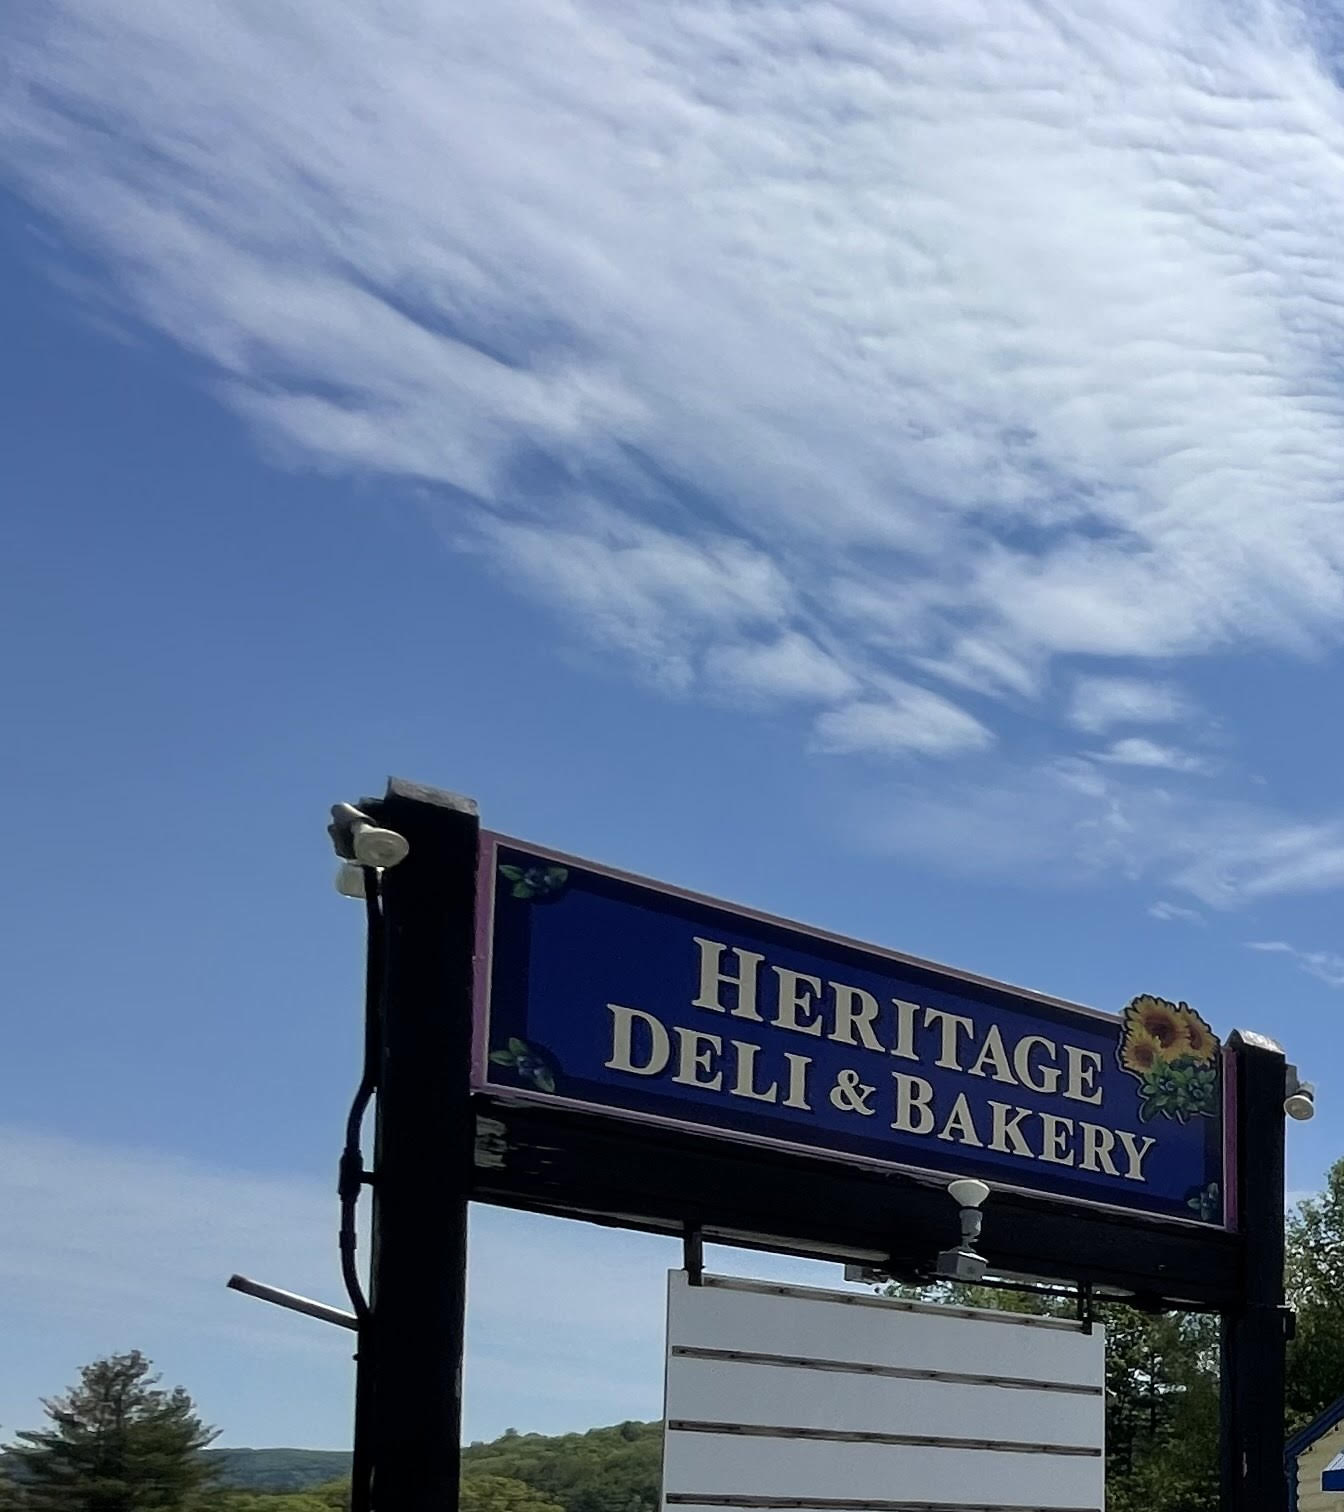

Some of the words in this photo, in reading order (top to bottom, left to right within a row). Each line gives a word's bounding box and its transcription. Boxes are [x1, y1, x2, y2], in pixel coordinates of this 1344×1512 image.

[604, 1002, 813, 1112] DELI
[829, 1068, 877, 1116] &
[889, 1071, 1157, 1182] BAKERY
[691, 934, 1104, 1107] HERITAGE
